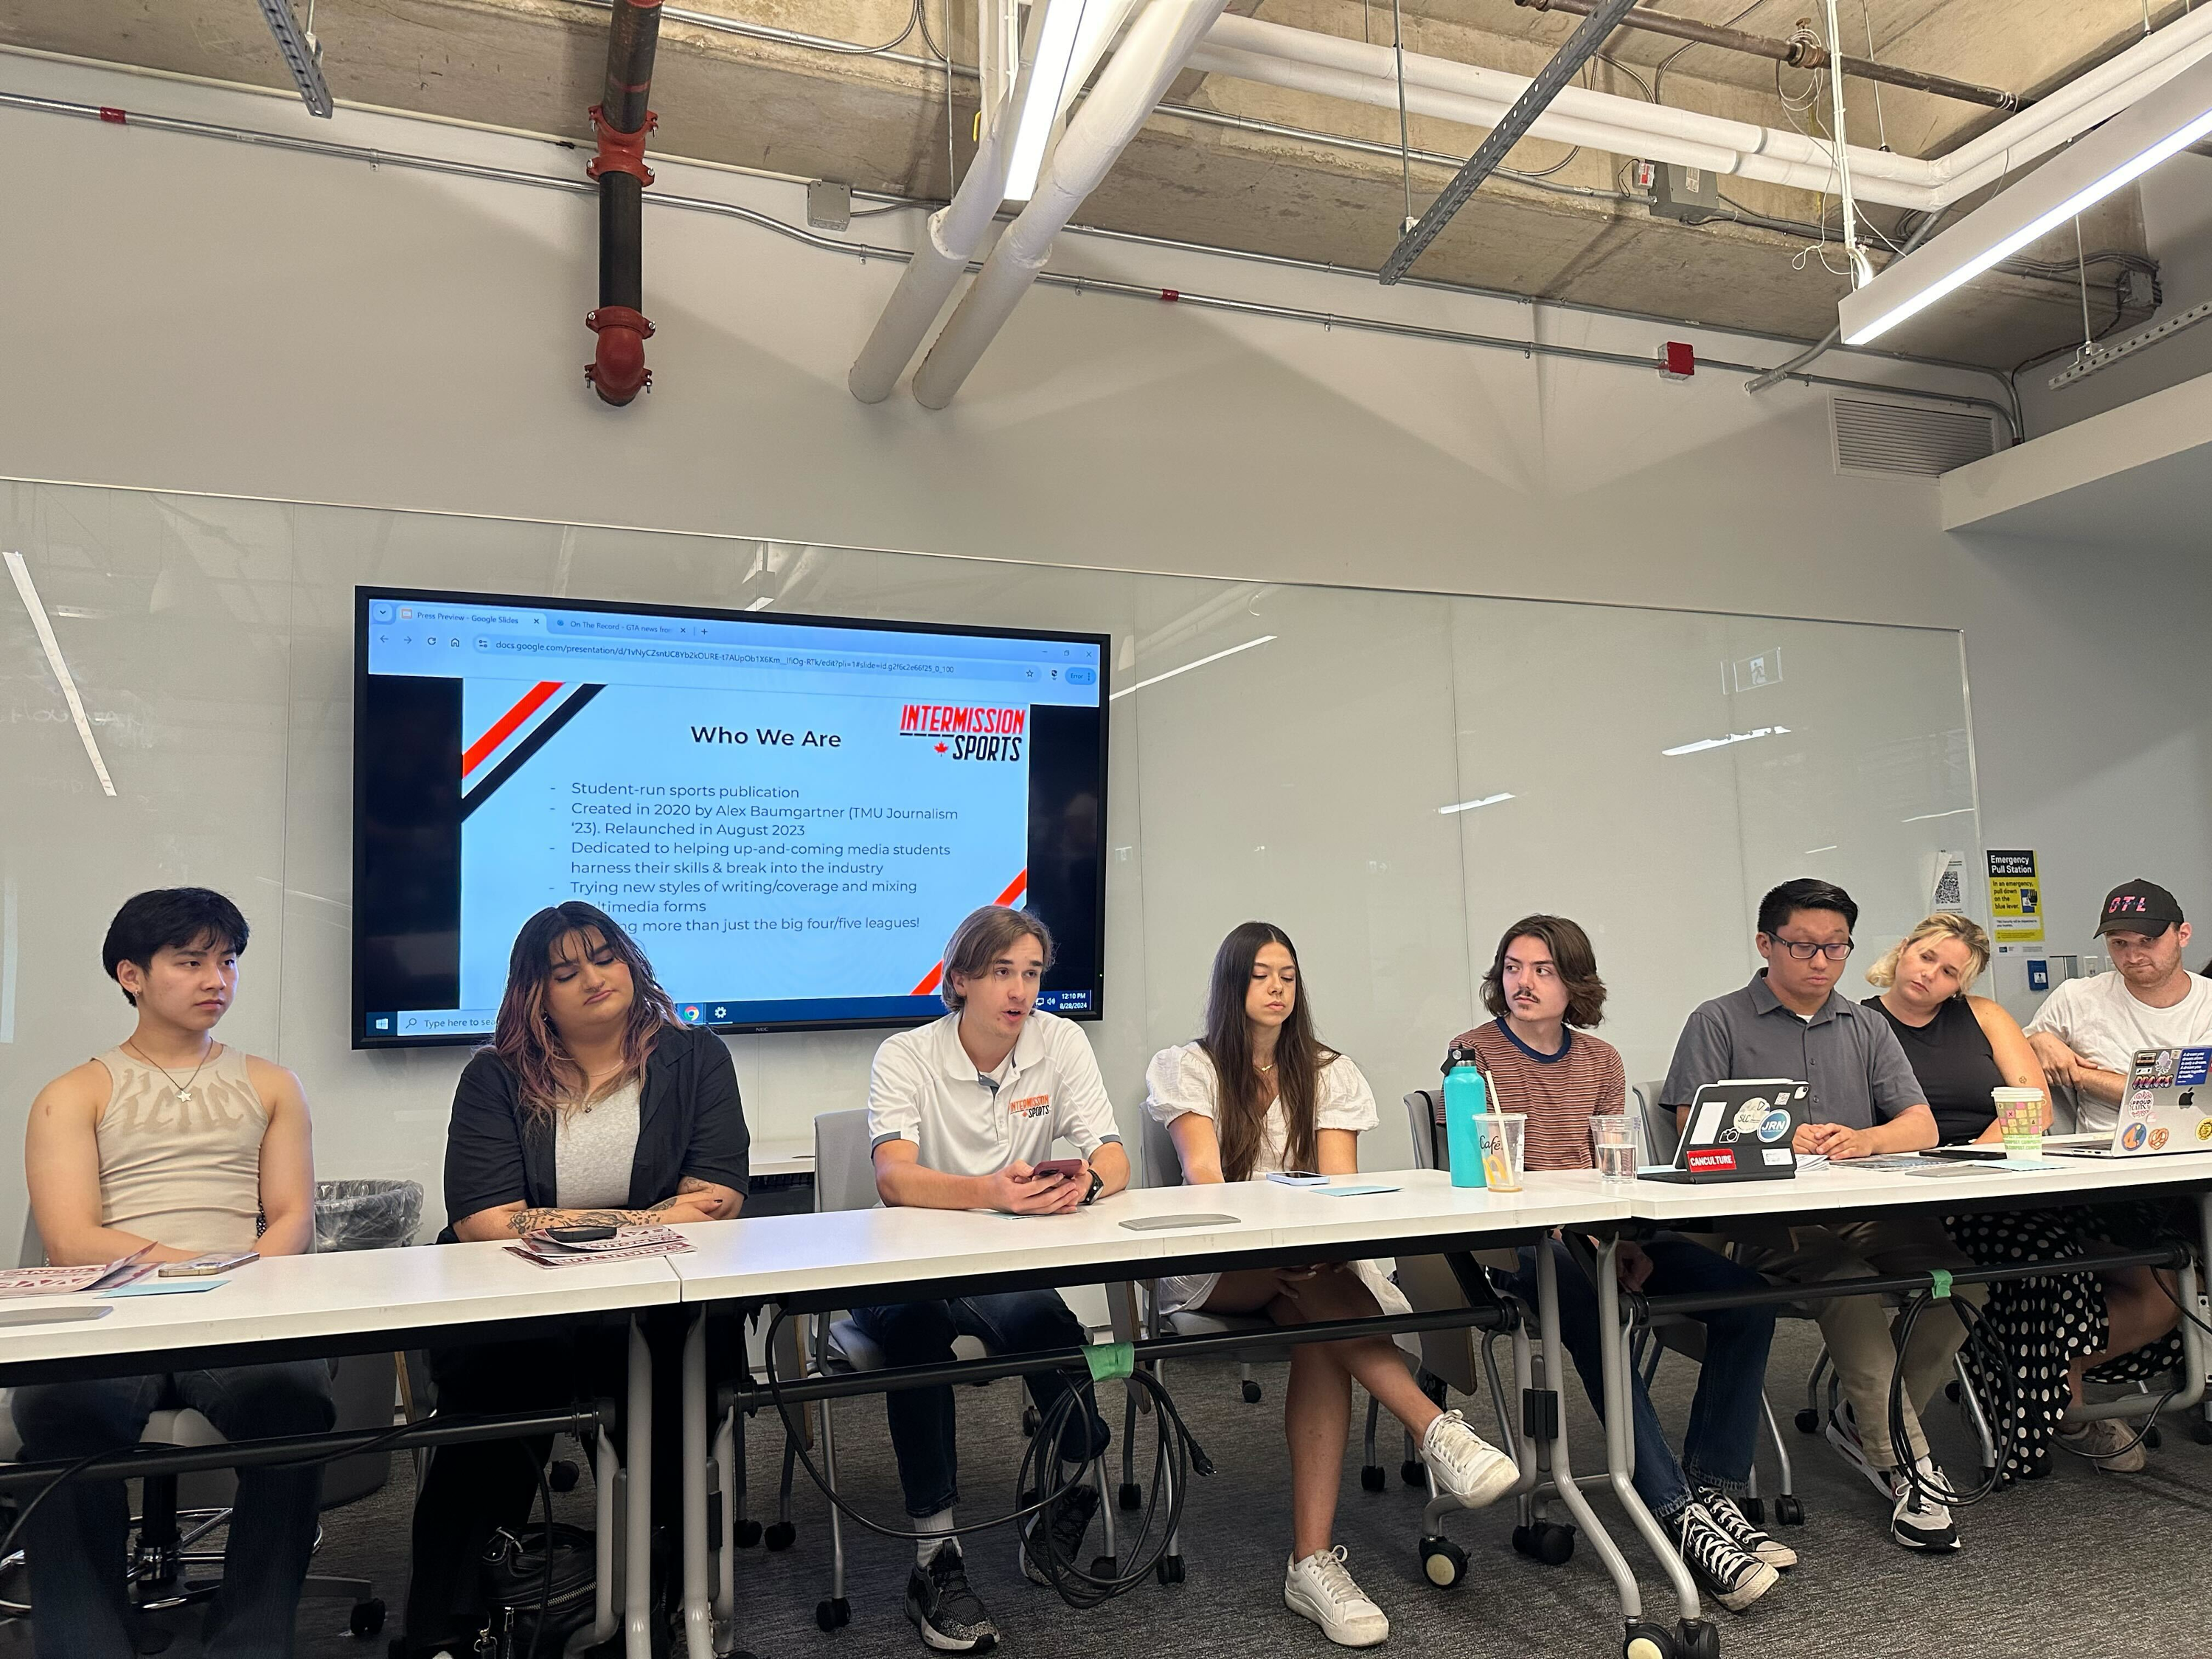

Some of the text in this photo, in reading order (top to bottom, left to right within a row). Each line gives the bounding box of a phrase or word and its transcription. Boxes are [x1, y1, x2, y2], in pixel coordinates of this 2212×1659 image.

[417, 611, 436, 619] Press
[437, 613, 465, 621] Preview
[471, 614, 497, 625] Google
[498, 616, 519, 625] Slides
[570, 620, 581, 628] On
[582, 621, 595, 629] The
[597, 622, 620, 630] Record
[900, 704, 1026, 734] INTERMISSION
[690, 726, 841, 748] Who We Are
[953, 736, 1022, 761] SPORTS
[571, 782, 799, 799] Student-run sports publication
[571, 802, 958, 821] Created in 2020 by Alex Baumgartner (TMU Journalism
[605, 822, 695, 835] Relaunched
[699, 823, 712, 835] in
[716, 824, 769, 838] August
[772, 824, 805, 836] 2023
[571, 841, 950, 858] Dedicated to helping up-and-coming media students
[1991, 855, 2029, 865] Emergency
[571, 861, 884, 876] harness their skills & break into the industry
[1992, 865, 2032, 874] Pull Station
[570, 879, 917, 896] Trying new styles of writing/coverage and mixing
[663, 900, 706, 912] forms
[2108, 896, 2146, 914] OTL
[642, 922, 682, 932] more
[685, 919, 720, 931] than
[722, 918, 750, 933] just
[754, 918, 778, 931] the
[782, 917, 803, 932] big
[807, 916, 862, 931] four/five
[866, 917, 919, 931] leagues!
[1060, 1002, 1088, 1010] 8/28/2024
[425, 1020, 445, 1029] Type
[1009, 1094, 1049, 1114] INTERMISSION
[1028, 1104, 1050, 1119] SPORTS
[1738, 1114, 1751, 1123] SLC
[1761, 1120, 1786, 1131] JRN
[1479, 1135, 1501, 1155] Café
[1690, 1155, 1733, 1166] CANCULTURE
